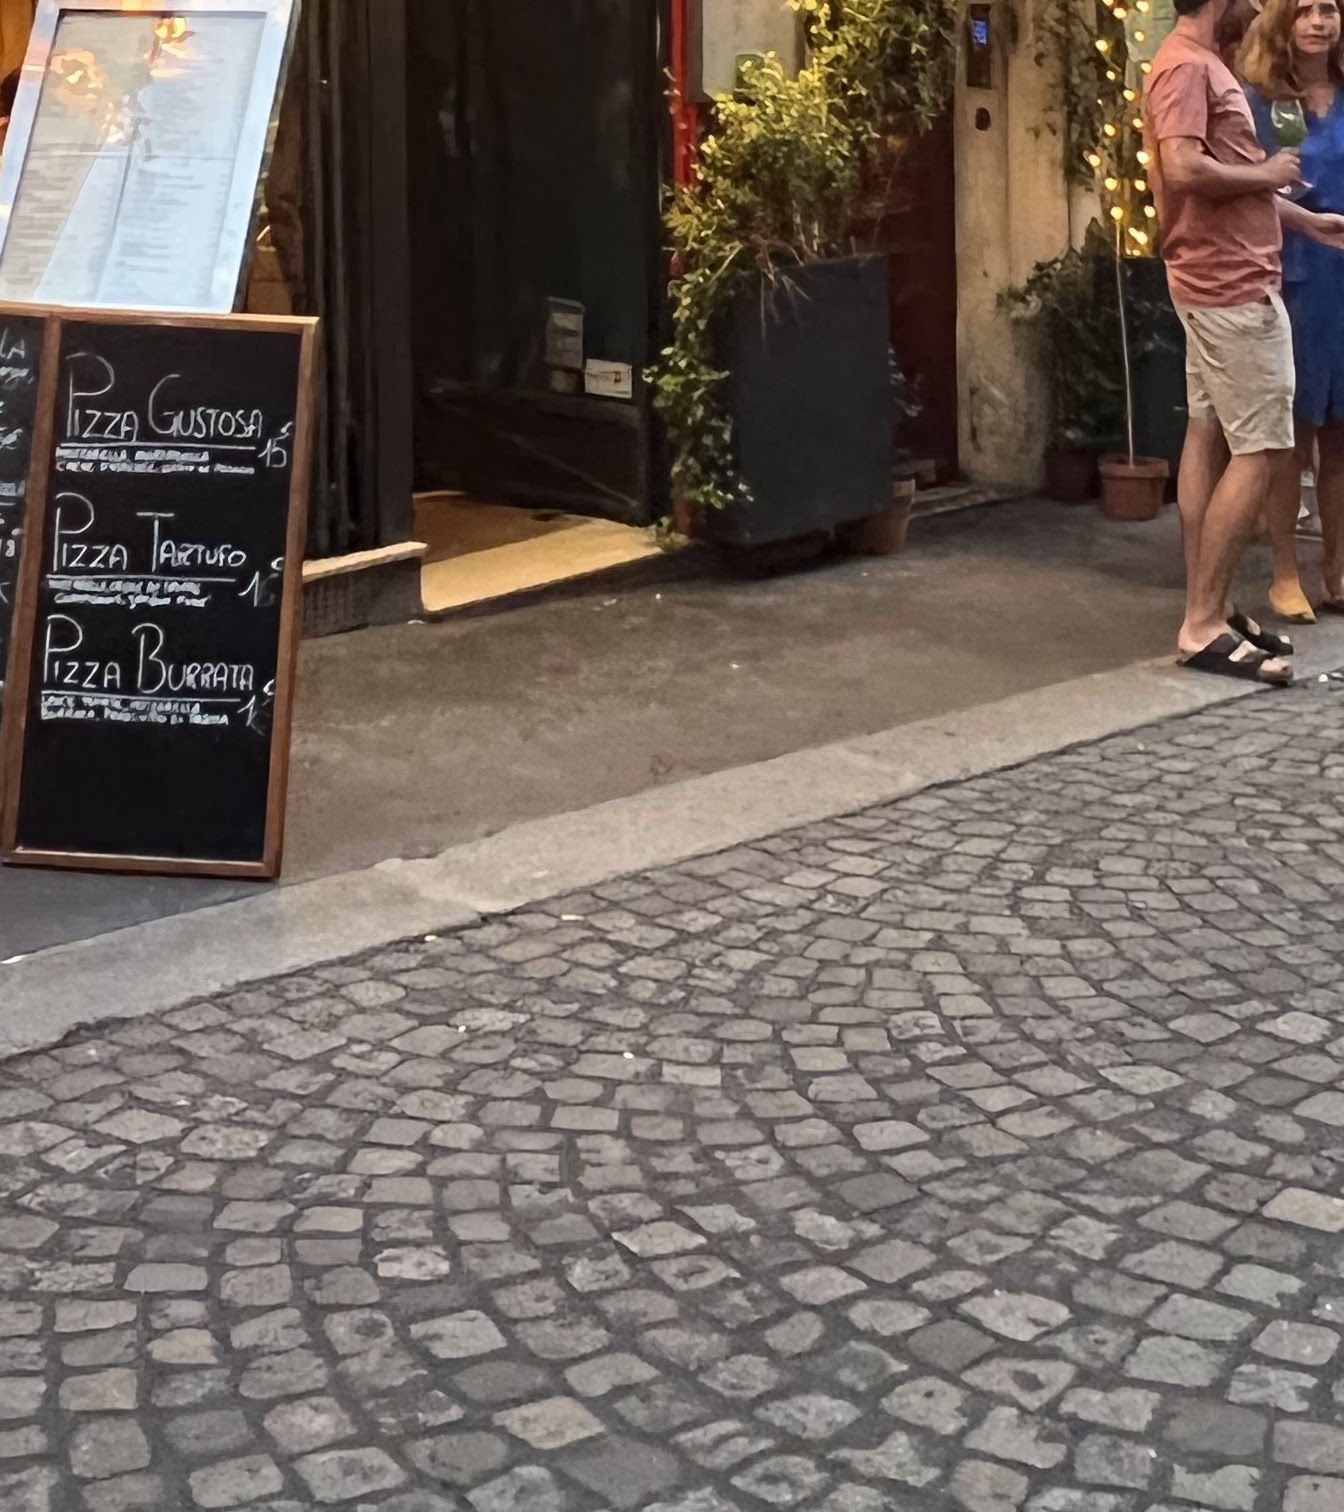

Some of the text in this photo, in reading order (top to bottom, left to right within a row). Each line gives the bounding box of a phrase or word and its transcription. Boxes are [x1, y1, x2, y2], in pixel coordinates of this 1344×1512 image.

[65, 352, 139, 443] PIZZA
[148, 374, 263, 439] GUSTOSA
[53, 492, 129, 572] PIZZA
[136, 511, 247, 573] TARTUFO
[44, 614, 121, 689] PIZZA
[132, 622, 255, 694] BURRATA
